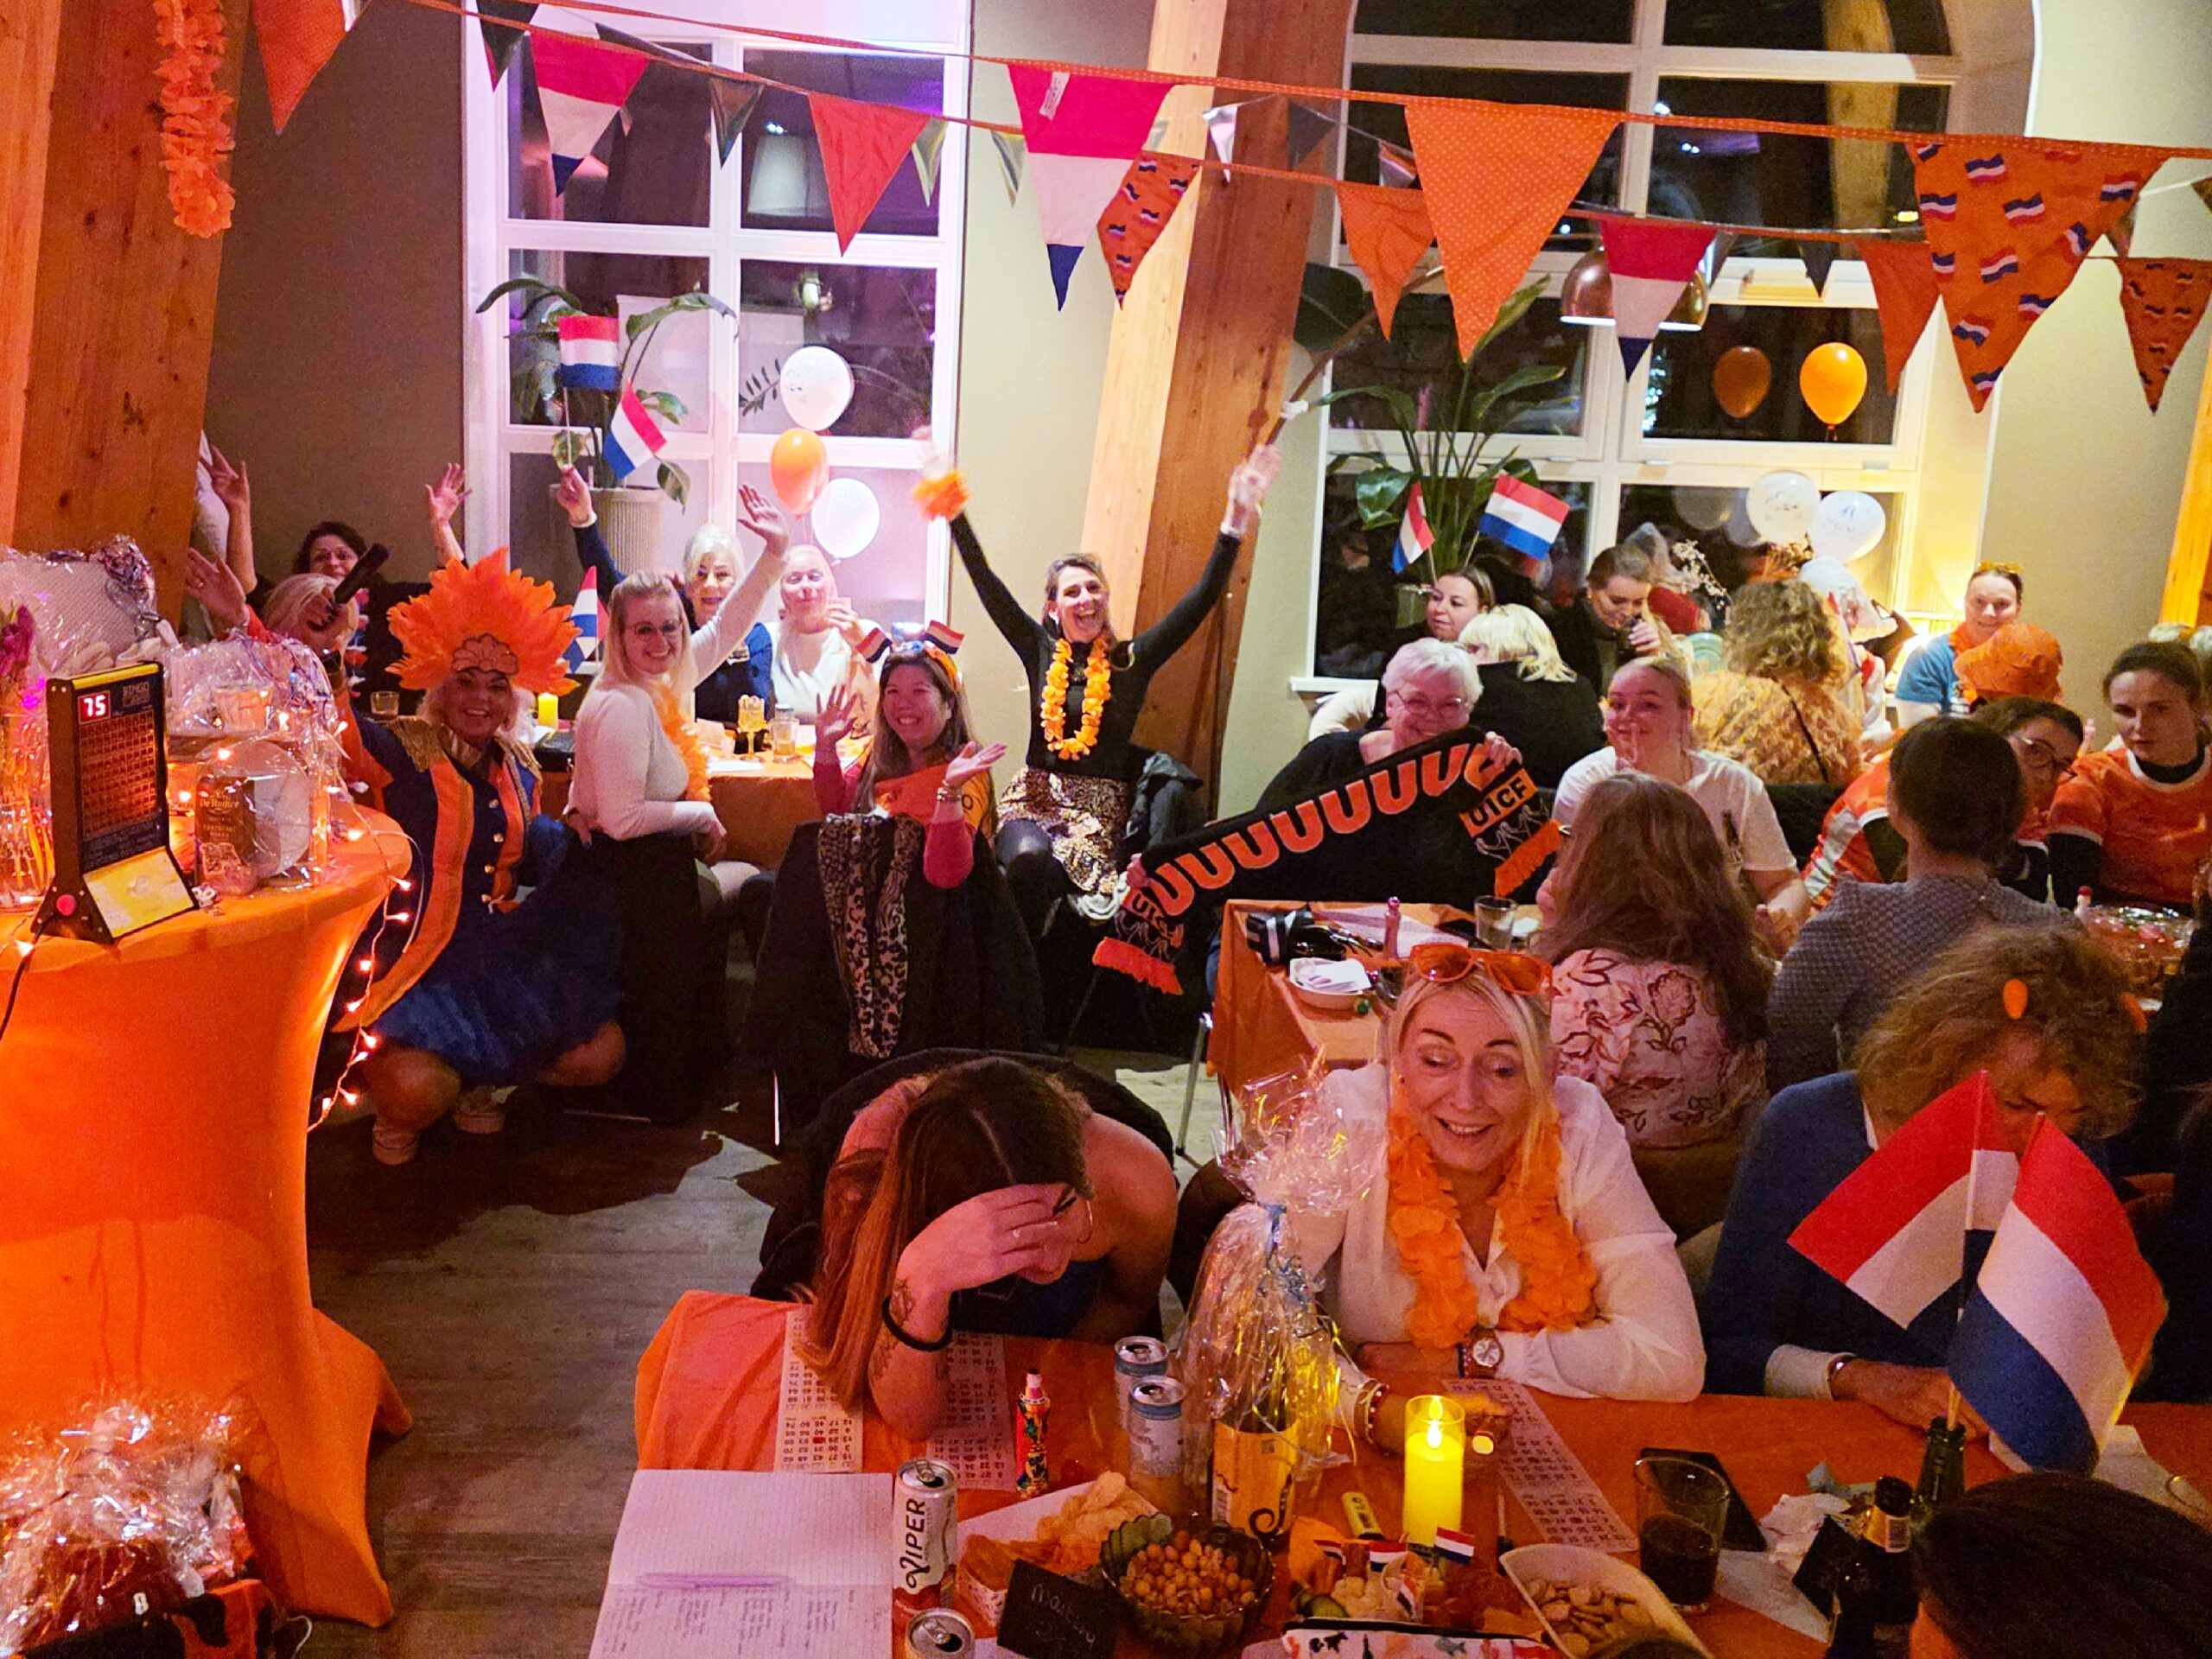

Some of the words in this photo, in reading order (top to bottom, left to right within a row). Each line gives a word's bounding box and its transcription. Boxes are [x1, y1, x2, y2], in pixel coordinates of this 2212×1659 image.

[84, 694, 106, 717] 75
[1469, 776, 1528, 827] UICF
[899, 1498, 931, 1589] VIPER
